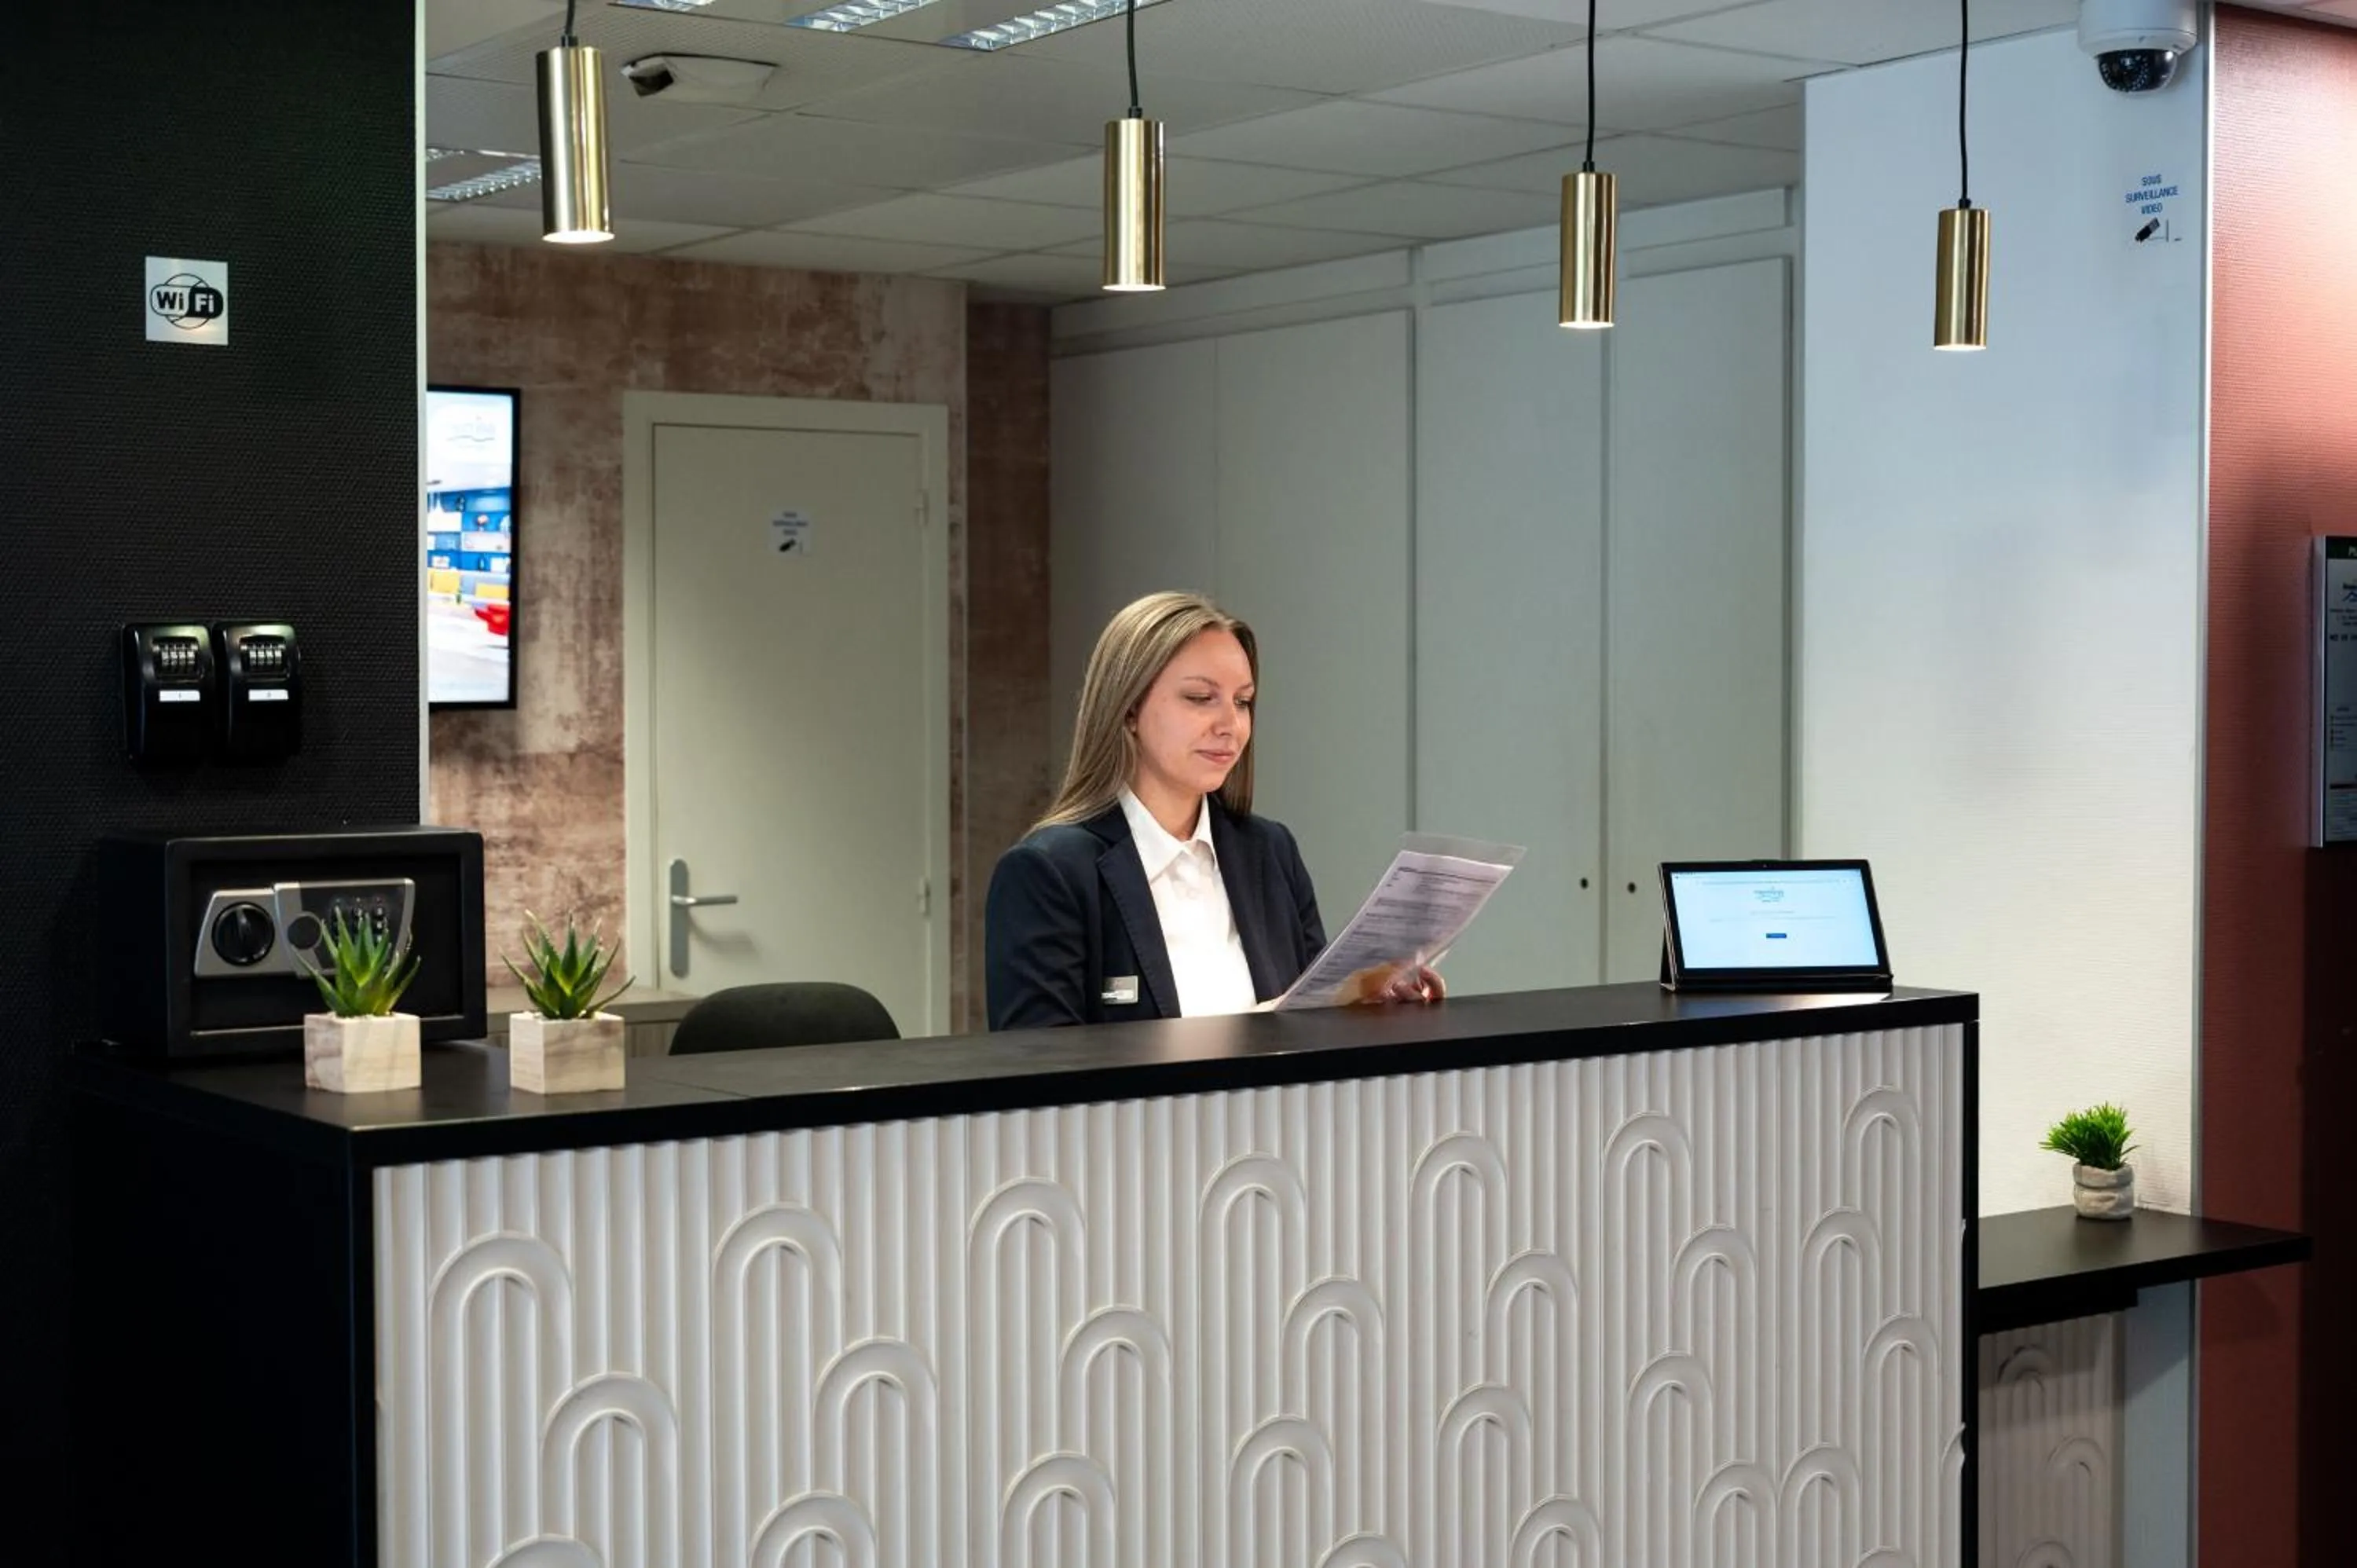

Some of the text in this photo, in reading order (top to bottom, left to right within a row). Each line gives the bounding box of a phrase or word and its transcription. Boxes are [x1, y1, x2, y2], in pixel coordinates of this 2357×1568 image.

[2141, 174, 2162, 186] SOUS
[2124, 185, 2179, 203] SURVEILLANCE
[2141, 203, 2163, 214] VIDEO
